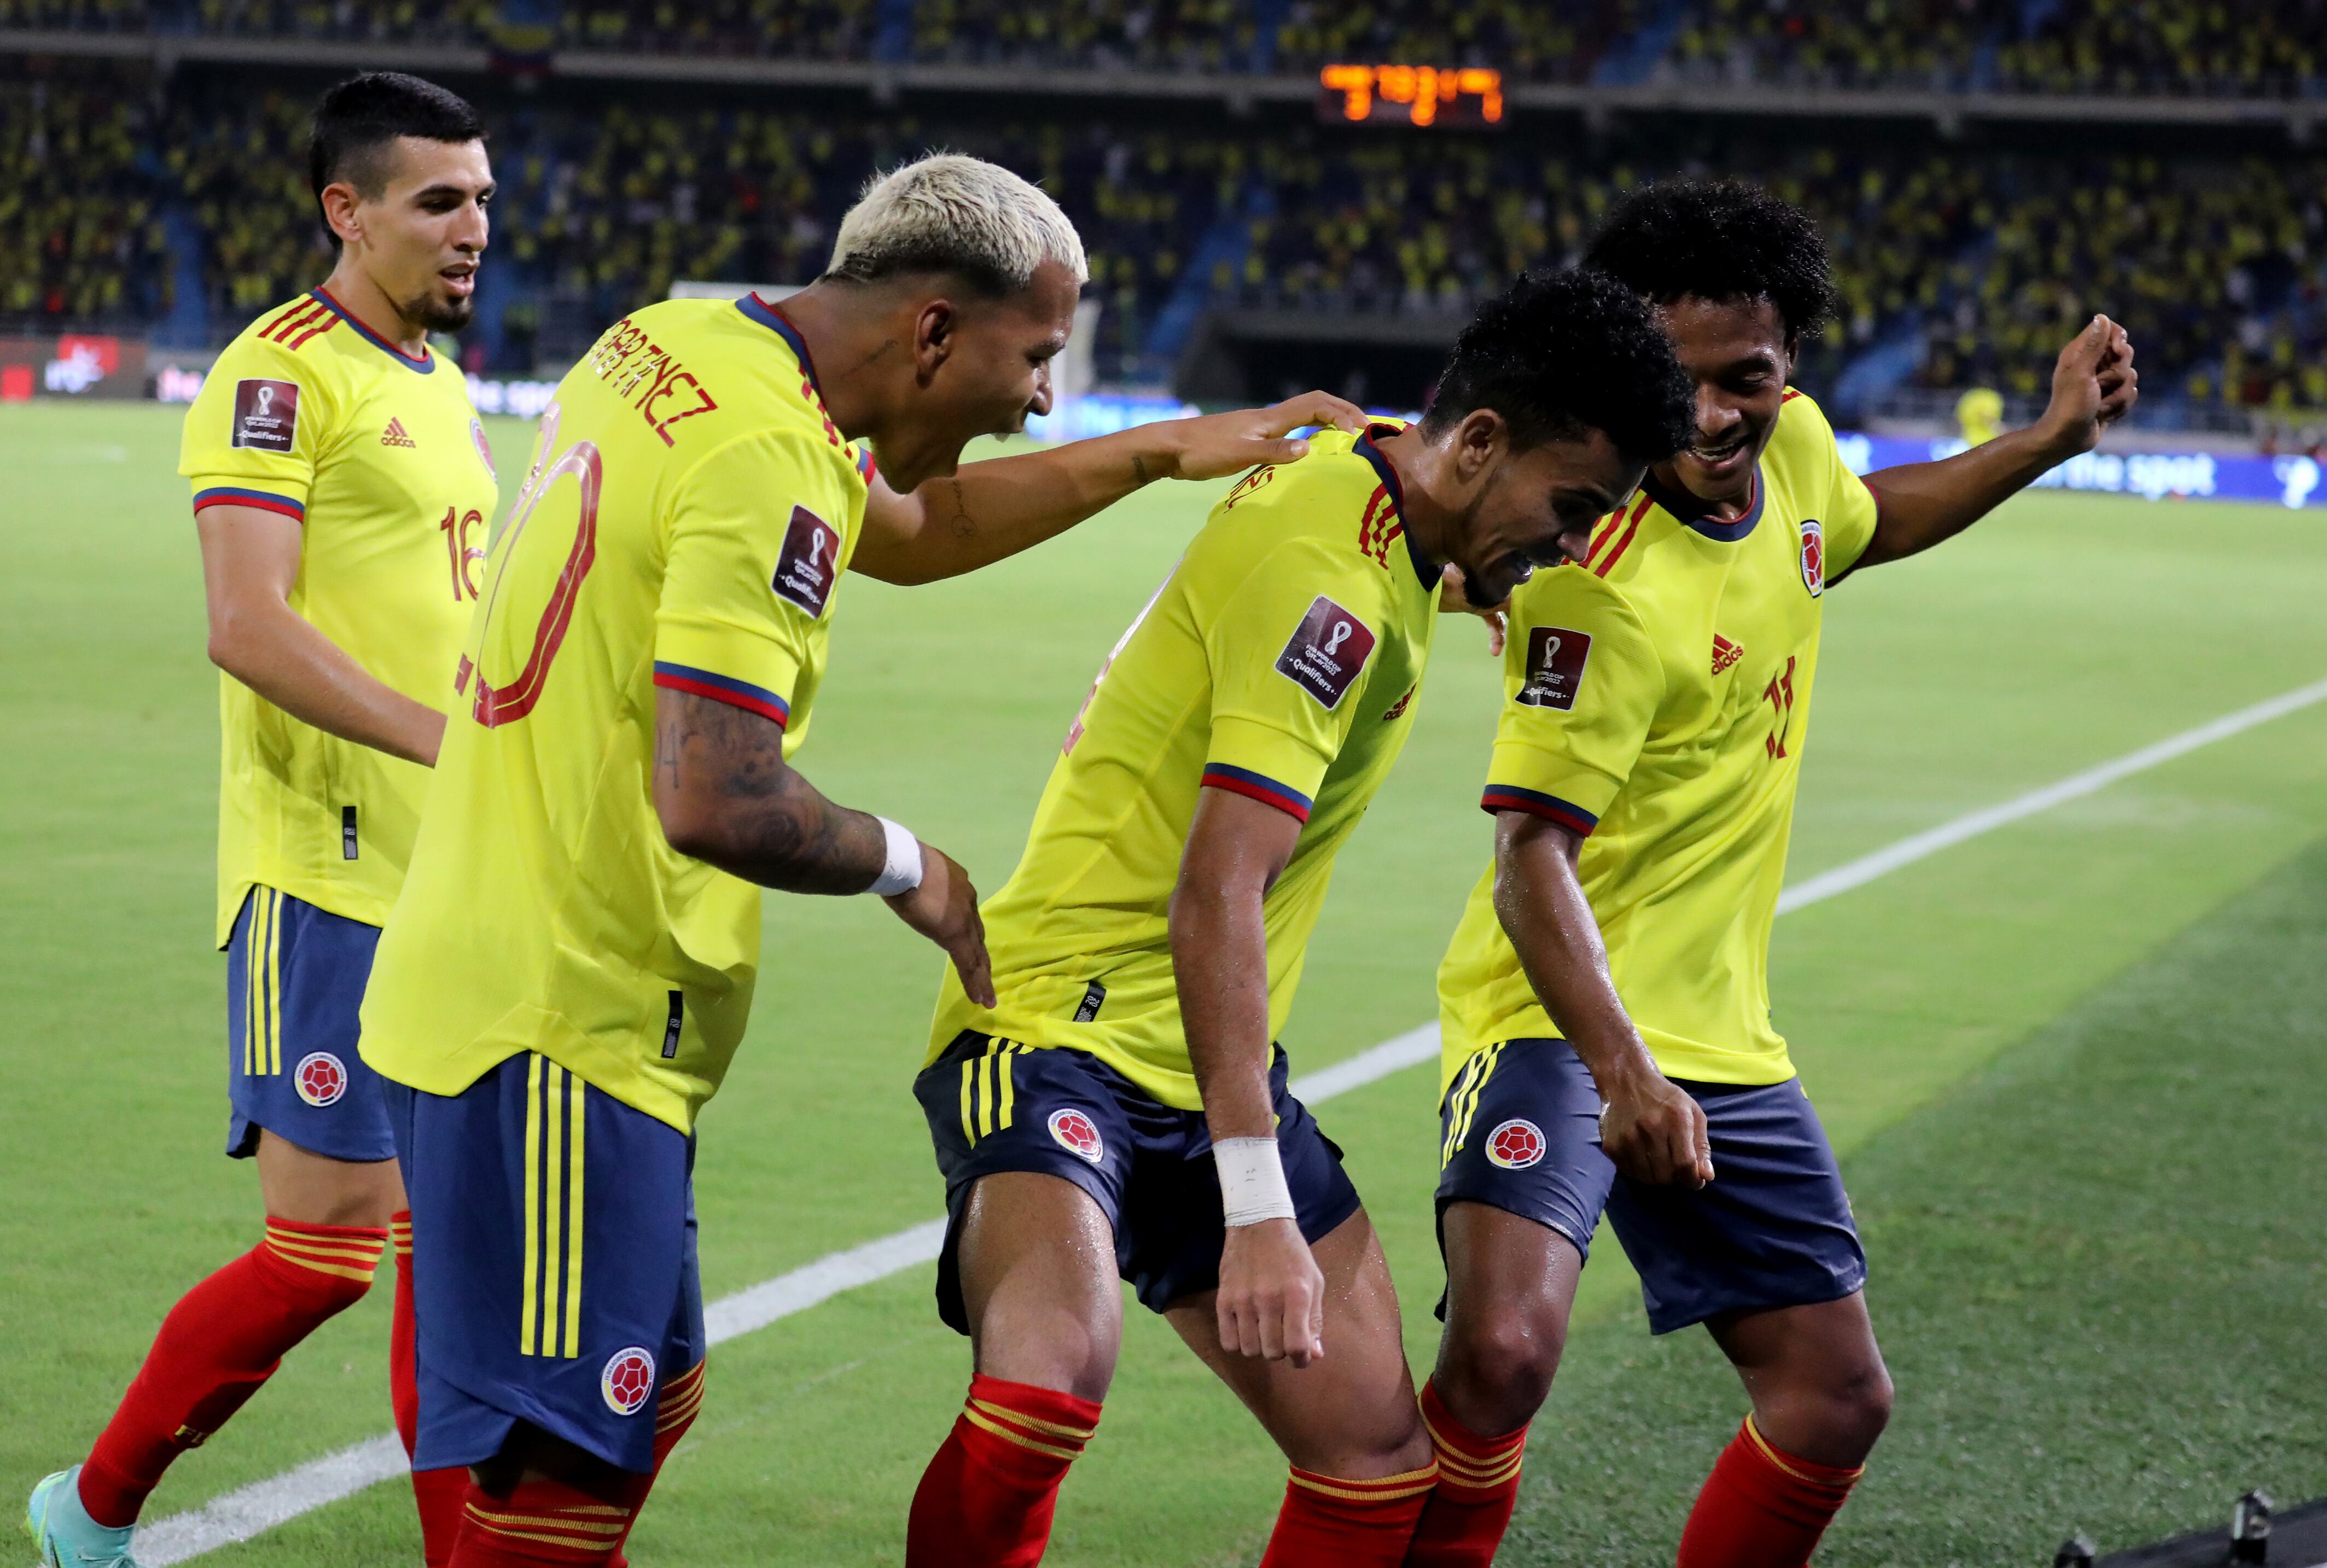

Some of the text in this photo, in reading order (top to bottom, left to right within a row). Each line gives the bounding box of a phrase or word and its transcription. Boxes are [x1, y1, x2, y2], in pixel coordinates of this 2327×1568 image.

[381, 434, 416, 448] adidas
[440, 506, 485, 601] 16
[1306, 644, 1342, 672] FIFA WORLD CUP
[1711, 646, 1744, 676] didas
[1293, 658, 1332, 691] Qualifiers
